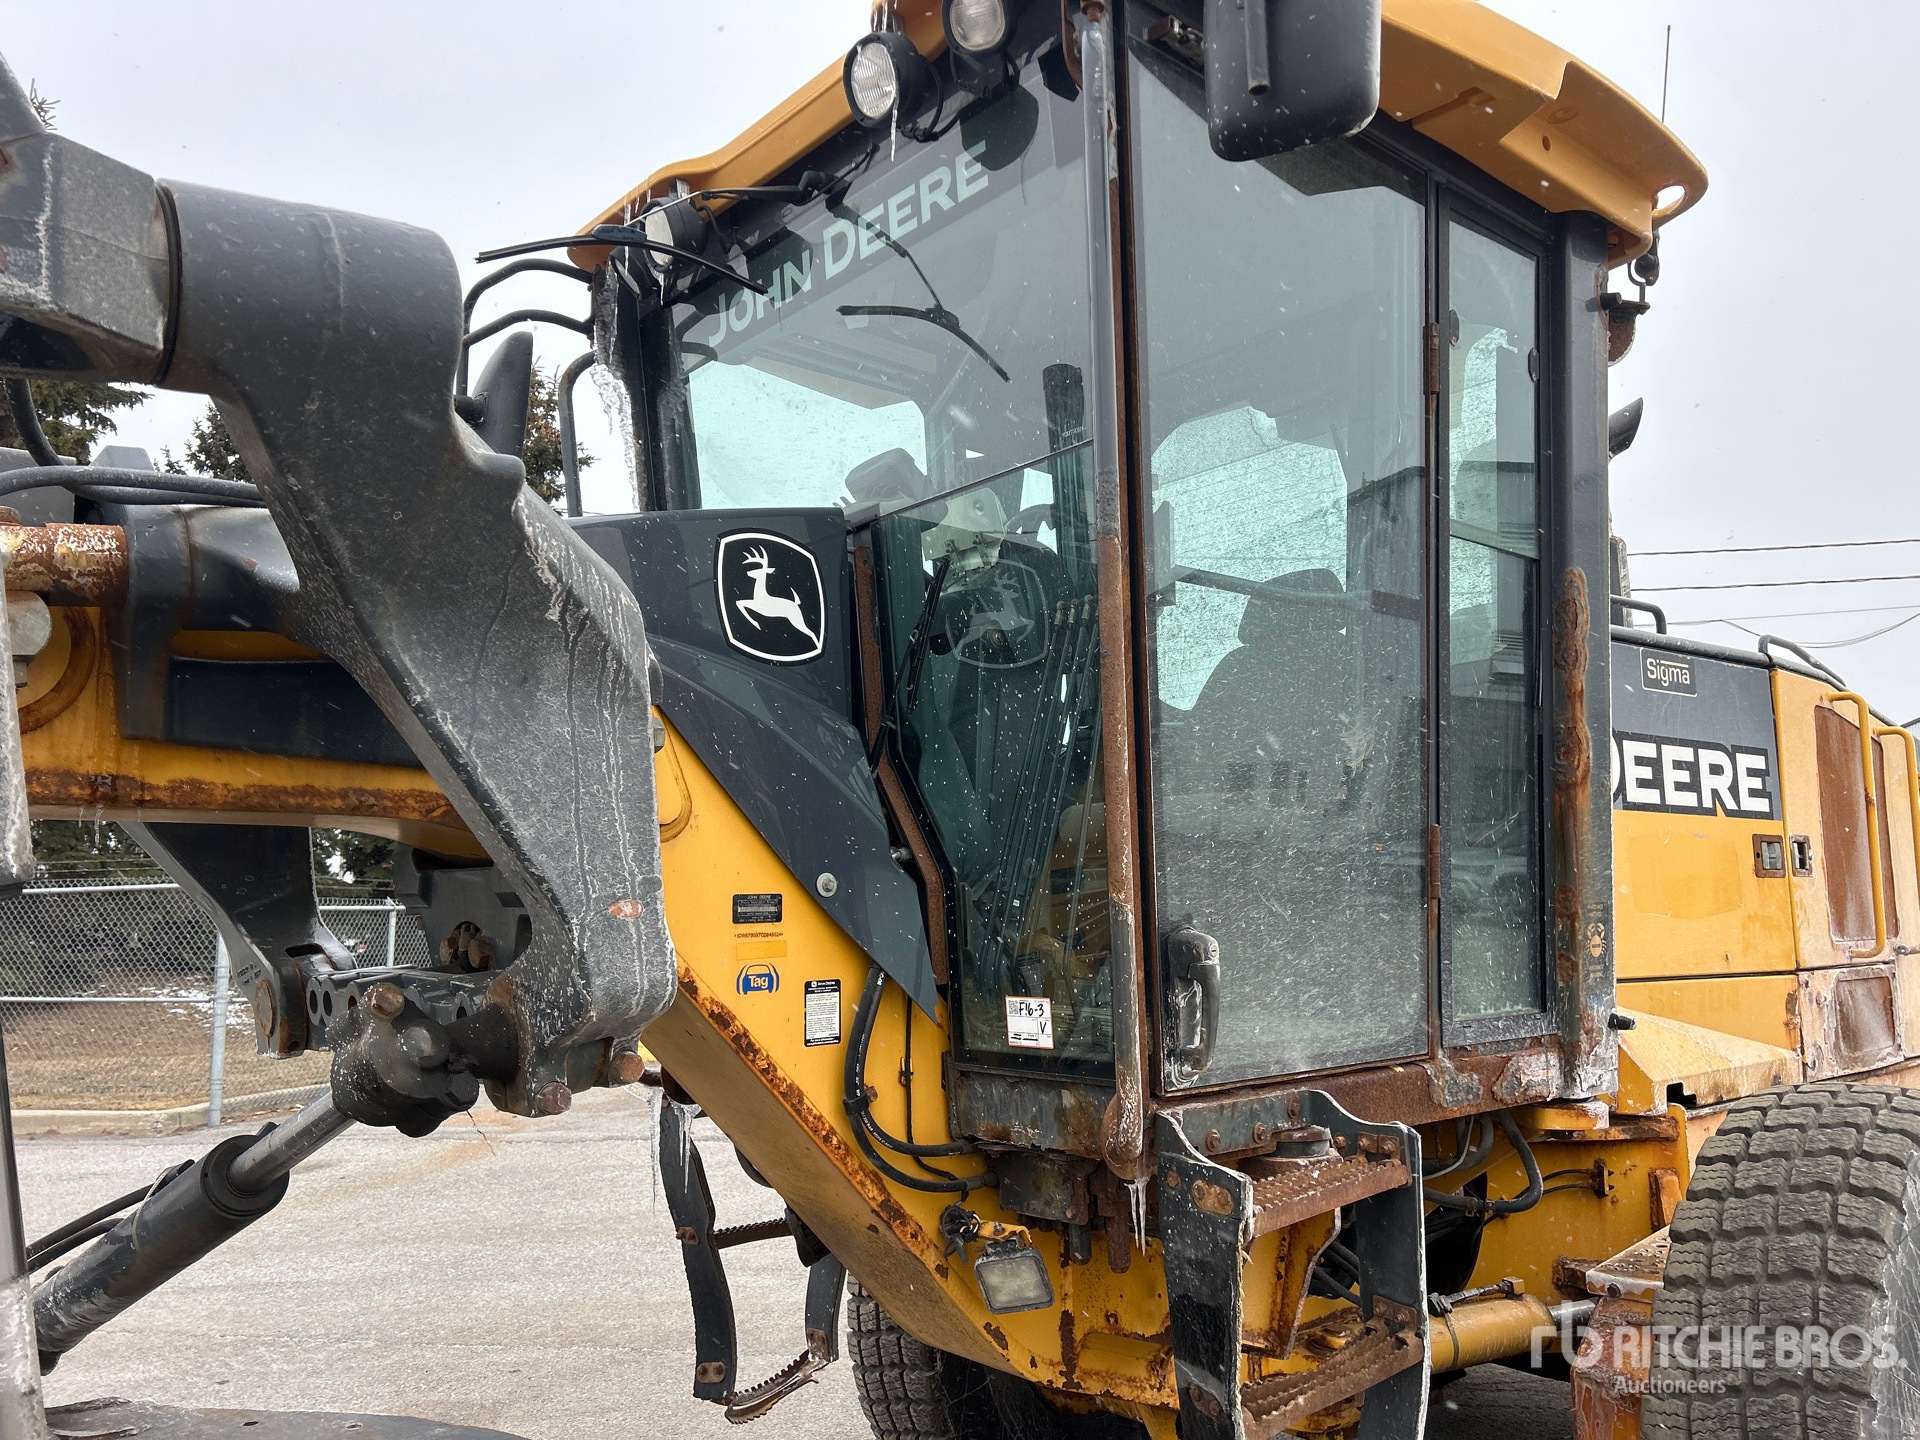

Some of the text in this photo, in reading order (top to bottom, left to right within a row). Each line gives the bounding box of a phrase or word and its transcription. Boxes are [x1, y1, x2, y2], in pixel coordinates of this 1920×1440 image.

[708, 139, 989, 347] JOHN DEERE
[1647, 658, 1690, 687] Sigma
[1612, 736, 1770, 813] EERE
[748, 975, 770, 989] Tag
[1040, 1021, 1047, 1034] V
